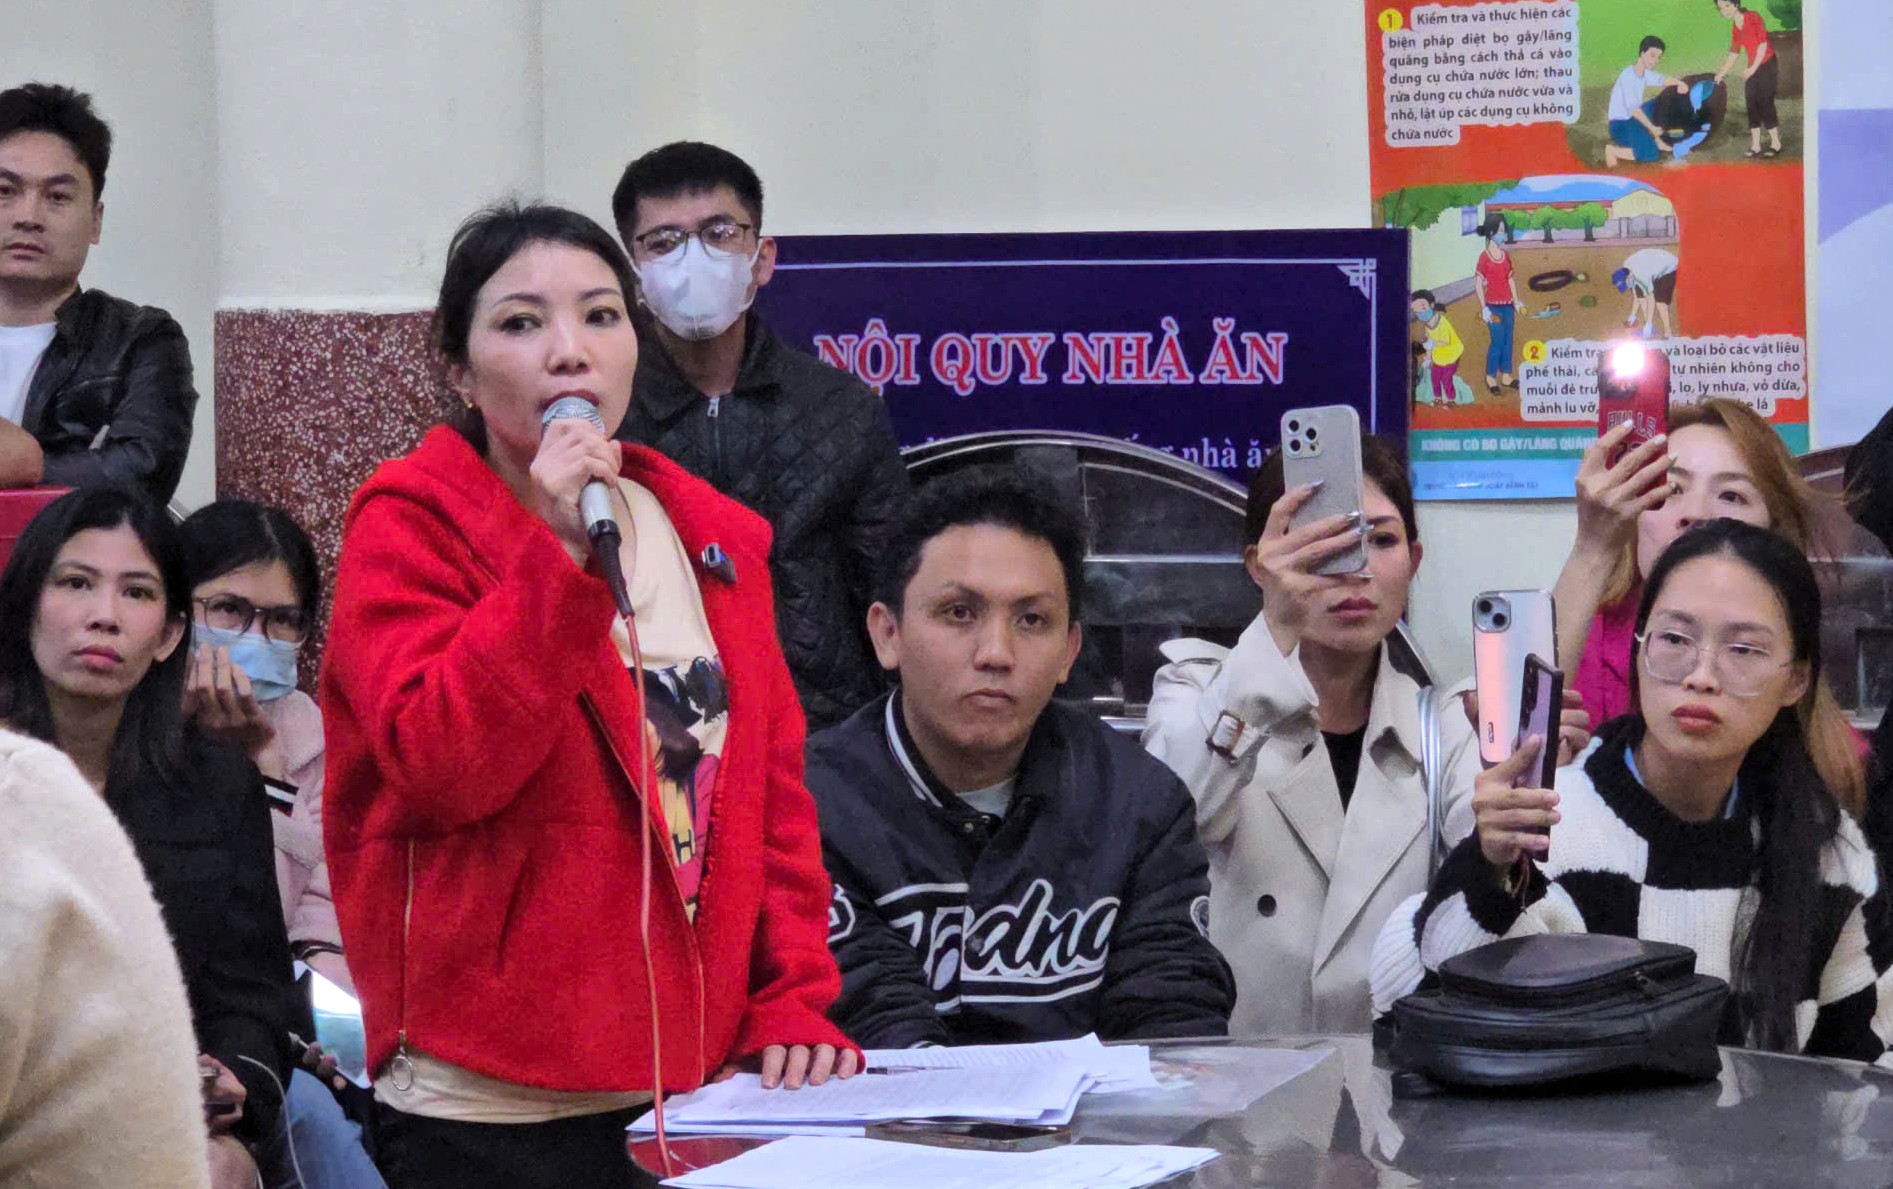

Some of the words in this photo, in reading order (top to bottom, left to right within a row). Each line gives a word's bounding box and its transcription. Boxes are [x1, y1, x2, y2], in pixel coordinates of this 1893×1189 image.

[1386, 14, 1393, 28] 1
[1451, 14, 1468, 23] tra
[1472, 12, 1486, 23] và
[1489, 10, 1517, 24] thực
[1521, 9, 1547, 22] hiện
[1552, 8, 1571, 18] các
[1389, 37, 1415, 50] biện
[1423, 35, 1454, 49] pháp
[1461, 33, 1485, 47] diệt
[1493, 32, 1509, 45] bọ
[1471, 50, 1498, 63] cách
[1504, 48, 1524, 61] thả
[1530, 48, 1544, 60] cá
[1550, 48, 1572, 59] vào
[1390, 73, 1421, 86] dụng
[1427, 74, 1440, 86] cụ
[1445, 69, 1474, 82] chứa
[1480, 67, 1510, 80] nước
[1515, 66, 1538, 79] lớn;
[1544, 66, 1572, 77] thau
[1413, 90, 1445, 104] dụng
[1448, 92, 1462, 104] cụ
[1465, 88, 1495, 100] chứa
[1499, 86, 1529, 98] nước
[1558, 84, 1573, 95] và
[1391, 108, 1417, 121] nhỏ,
[1420, 109, 1435, 122] lật
[1439, 107, 1454, 121] úp
[1458, 106, 1477, 118] các
[1480, 106, 1513, 119] dụng
[1516, 106, 1530, 118] cụ
[1533, 103, 1574, 117] không
[1391, 127, 1420, 141] chứa
[1424, 126, 1454, 139] nước
[813, 318, 921, 396] NỘI
[930, 331, 1055, 396] QUY
[1063, 316, 1193, 386] NHÀ
[1199, 318, 1289, 386] ĂN
[1530, 346, 1539, 359] 2
[1665, 344, 1680, 356] và
[1683, 344, 1707, 358] loại
[1709, 343, 1727, 356] bỏ
[1729, 342, 1750, 355] các
[1752, 343, 1773, 358] vật
[1776, 342, 1800, 357] liệu
[1526, 365, 1549, 379] phế
[1553, 365, 1580, 378] thải,
[1672, 364, 1686, 377] tự
[1689, 361, 1726, 375] nhiên
[1731, 361, 1773, 376] không
[1777, 361, 1800, 372] cho
[1527, 383, 1558, 395] muỗi
[1561, 383, 1576, 395] đẻ
[1699, 381, 1710, 395] ly
[1713, 381, 1750, 395] nhựa,
[1753, 378, 1769, 391] vỏ
[1527, 402, 1562, 414] mảnh
[1565, 402, 1577, 413] lu
[1757, 397, 1768, 410] lá
[1182, 437, 1238, 468] nhà
